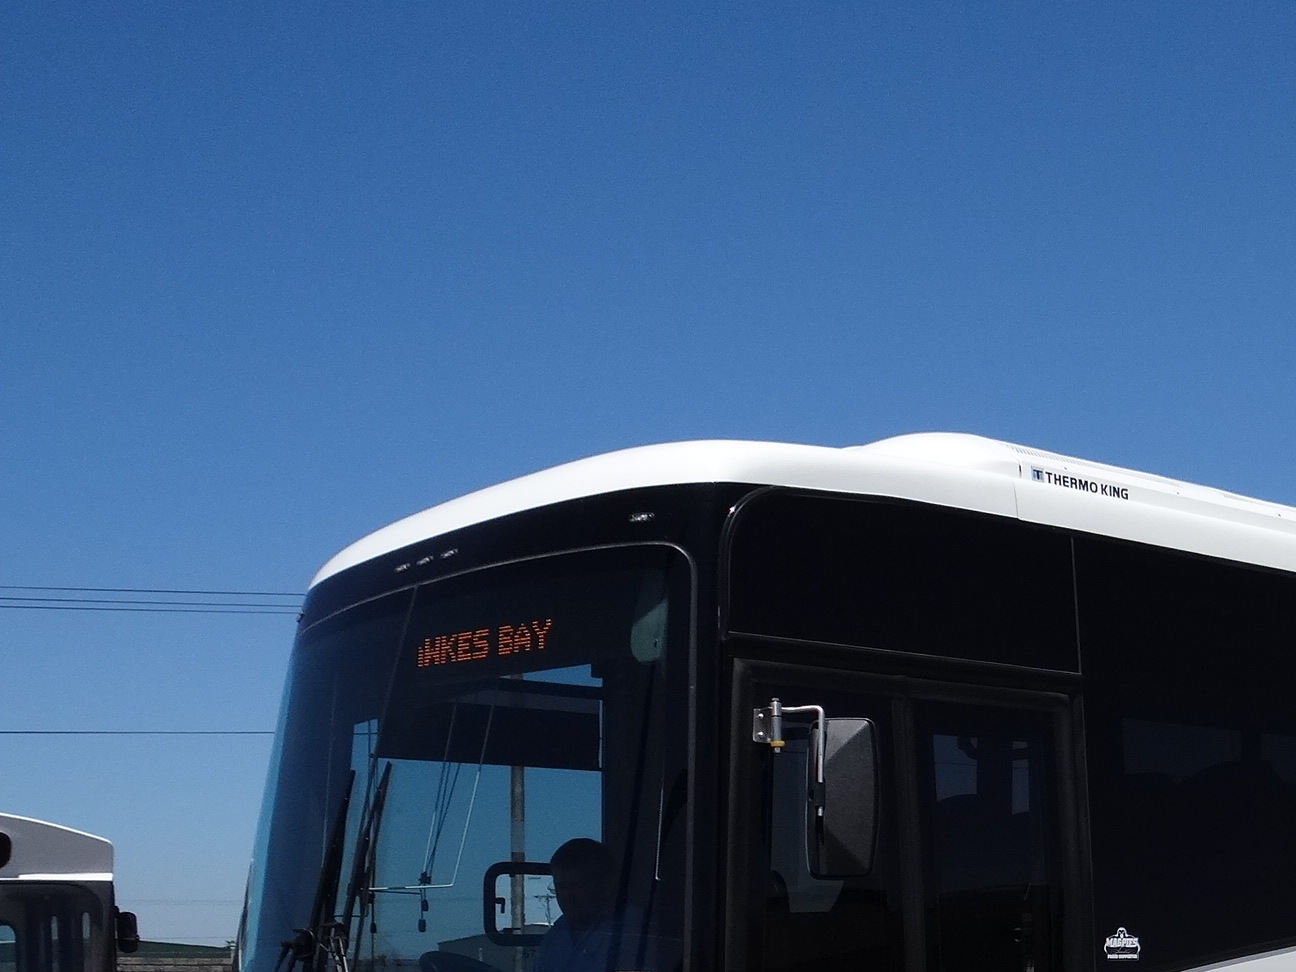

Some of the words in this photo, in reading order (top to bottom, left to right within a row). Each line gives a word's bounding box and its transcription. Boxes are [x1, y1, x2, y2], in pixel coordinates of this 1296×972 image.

[1045, 471, 1098, 493] THERMO
[1100, 483, 1129, 500] KING
[498, 618, 552, 655] BAY
